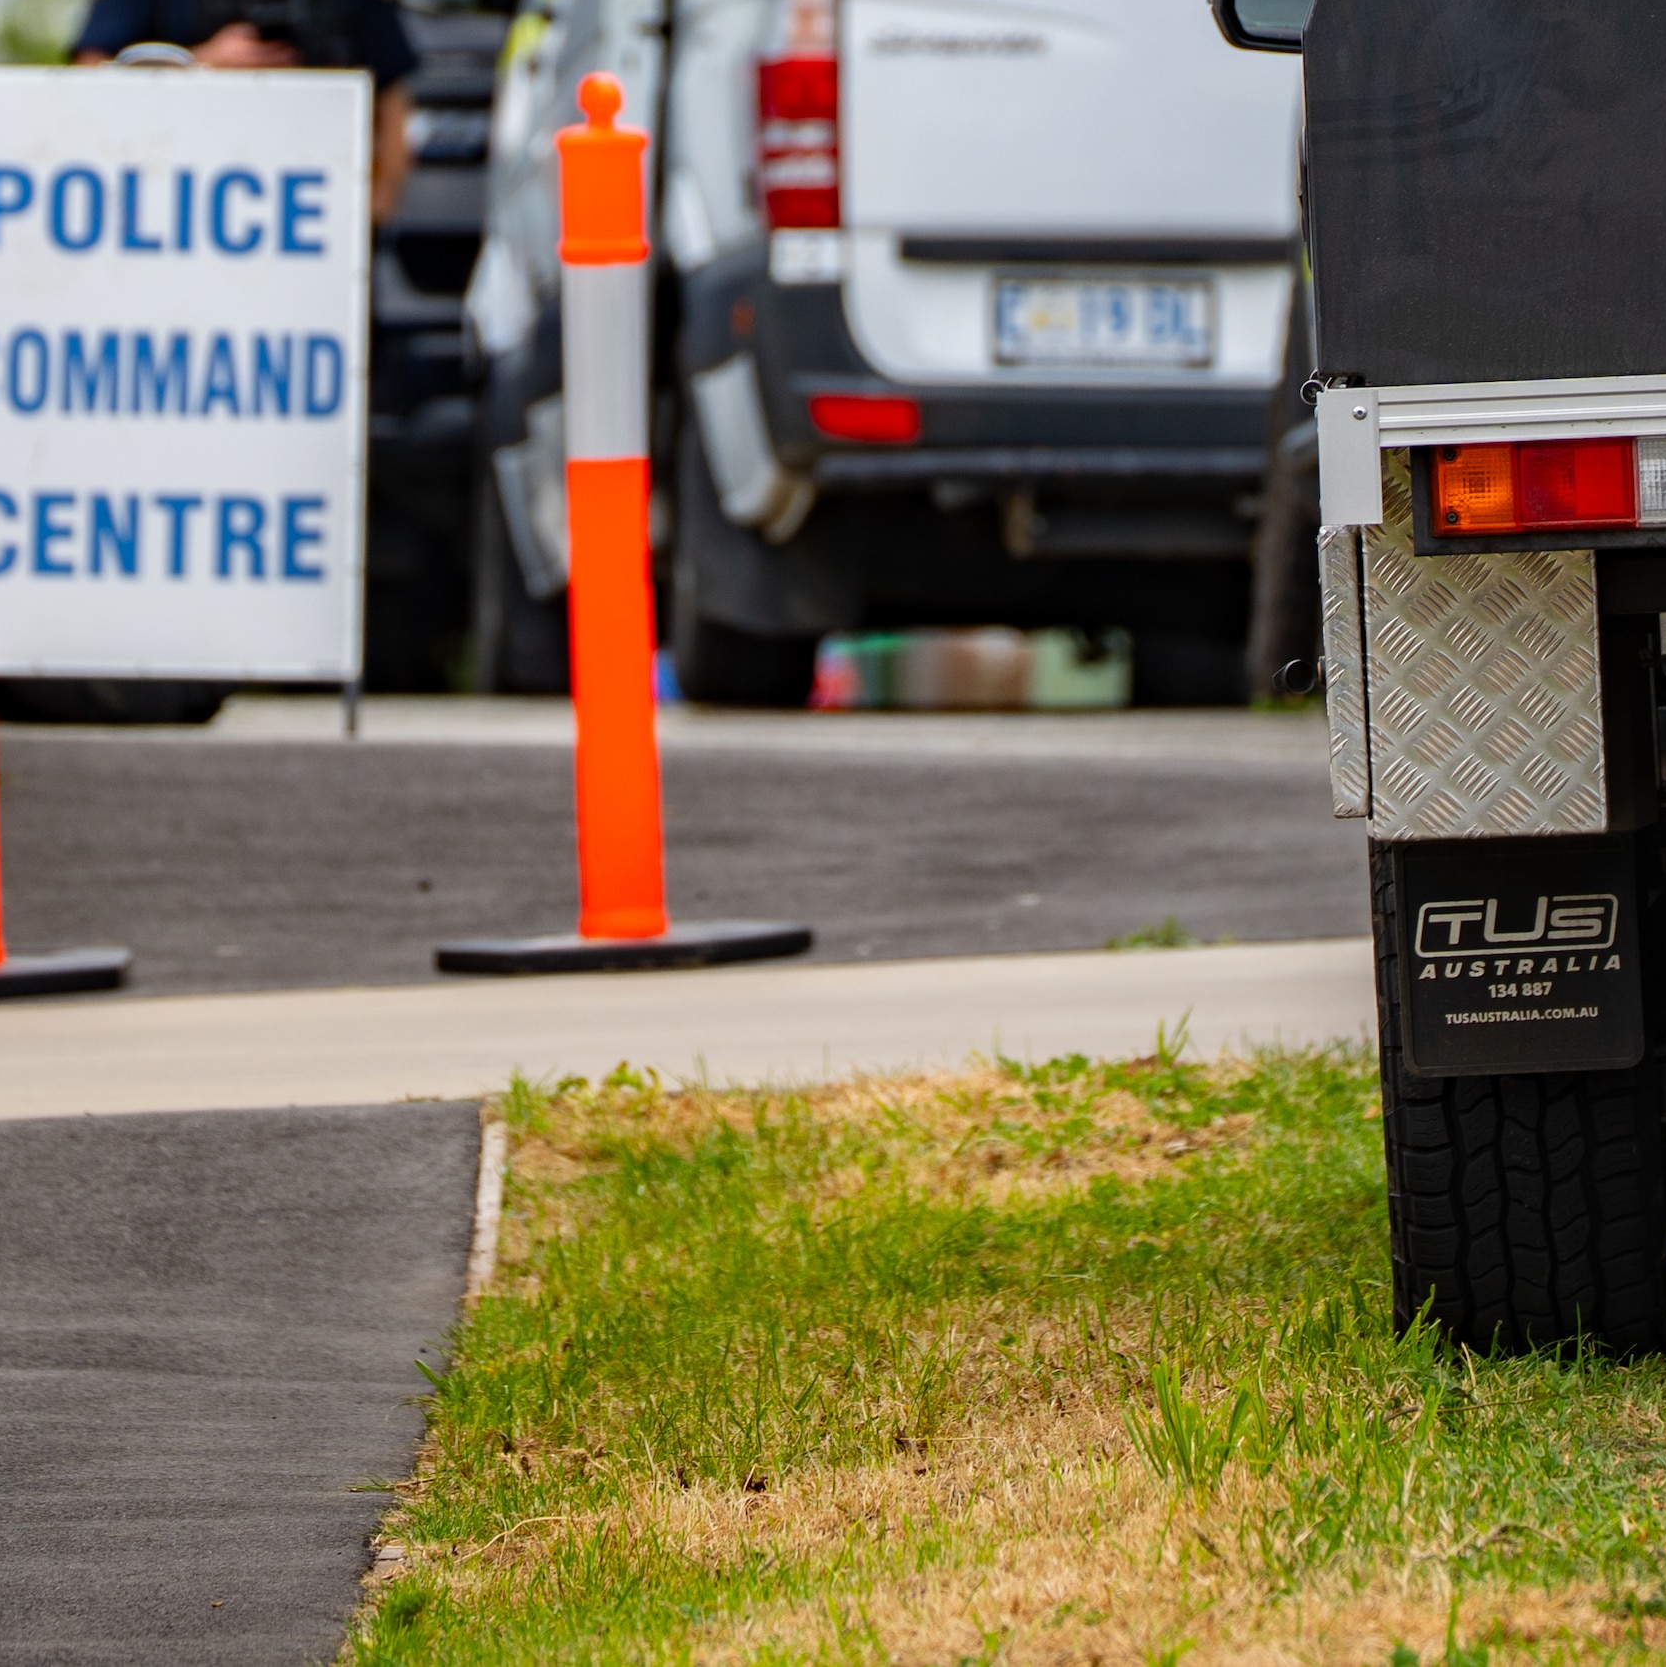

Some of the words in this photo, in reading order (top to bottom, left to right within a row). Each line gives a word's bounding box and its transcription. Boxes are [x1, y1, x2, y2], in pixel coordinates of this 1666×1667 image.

[1428, 895, 1605, 945] TUS
[1419, 954, 1622, 980] AUSTRALIA
[1488, 983, 1518, 998] 134
[1522, 982, 1553, 997] 887
[1445, 1006, 1599, 1025] TUSAUSTRALIA.COM.AU
